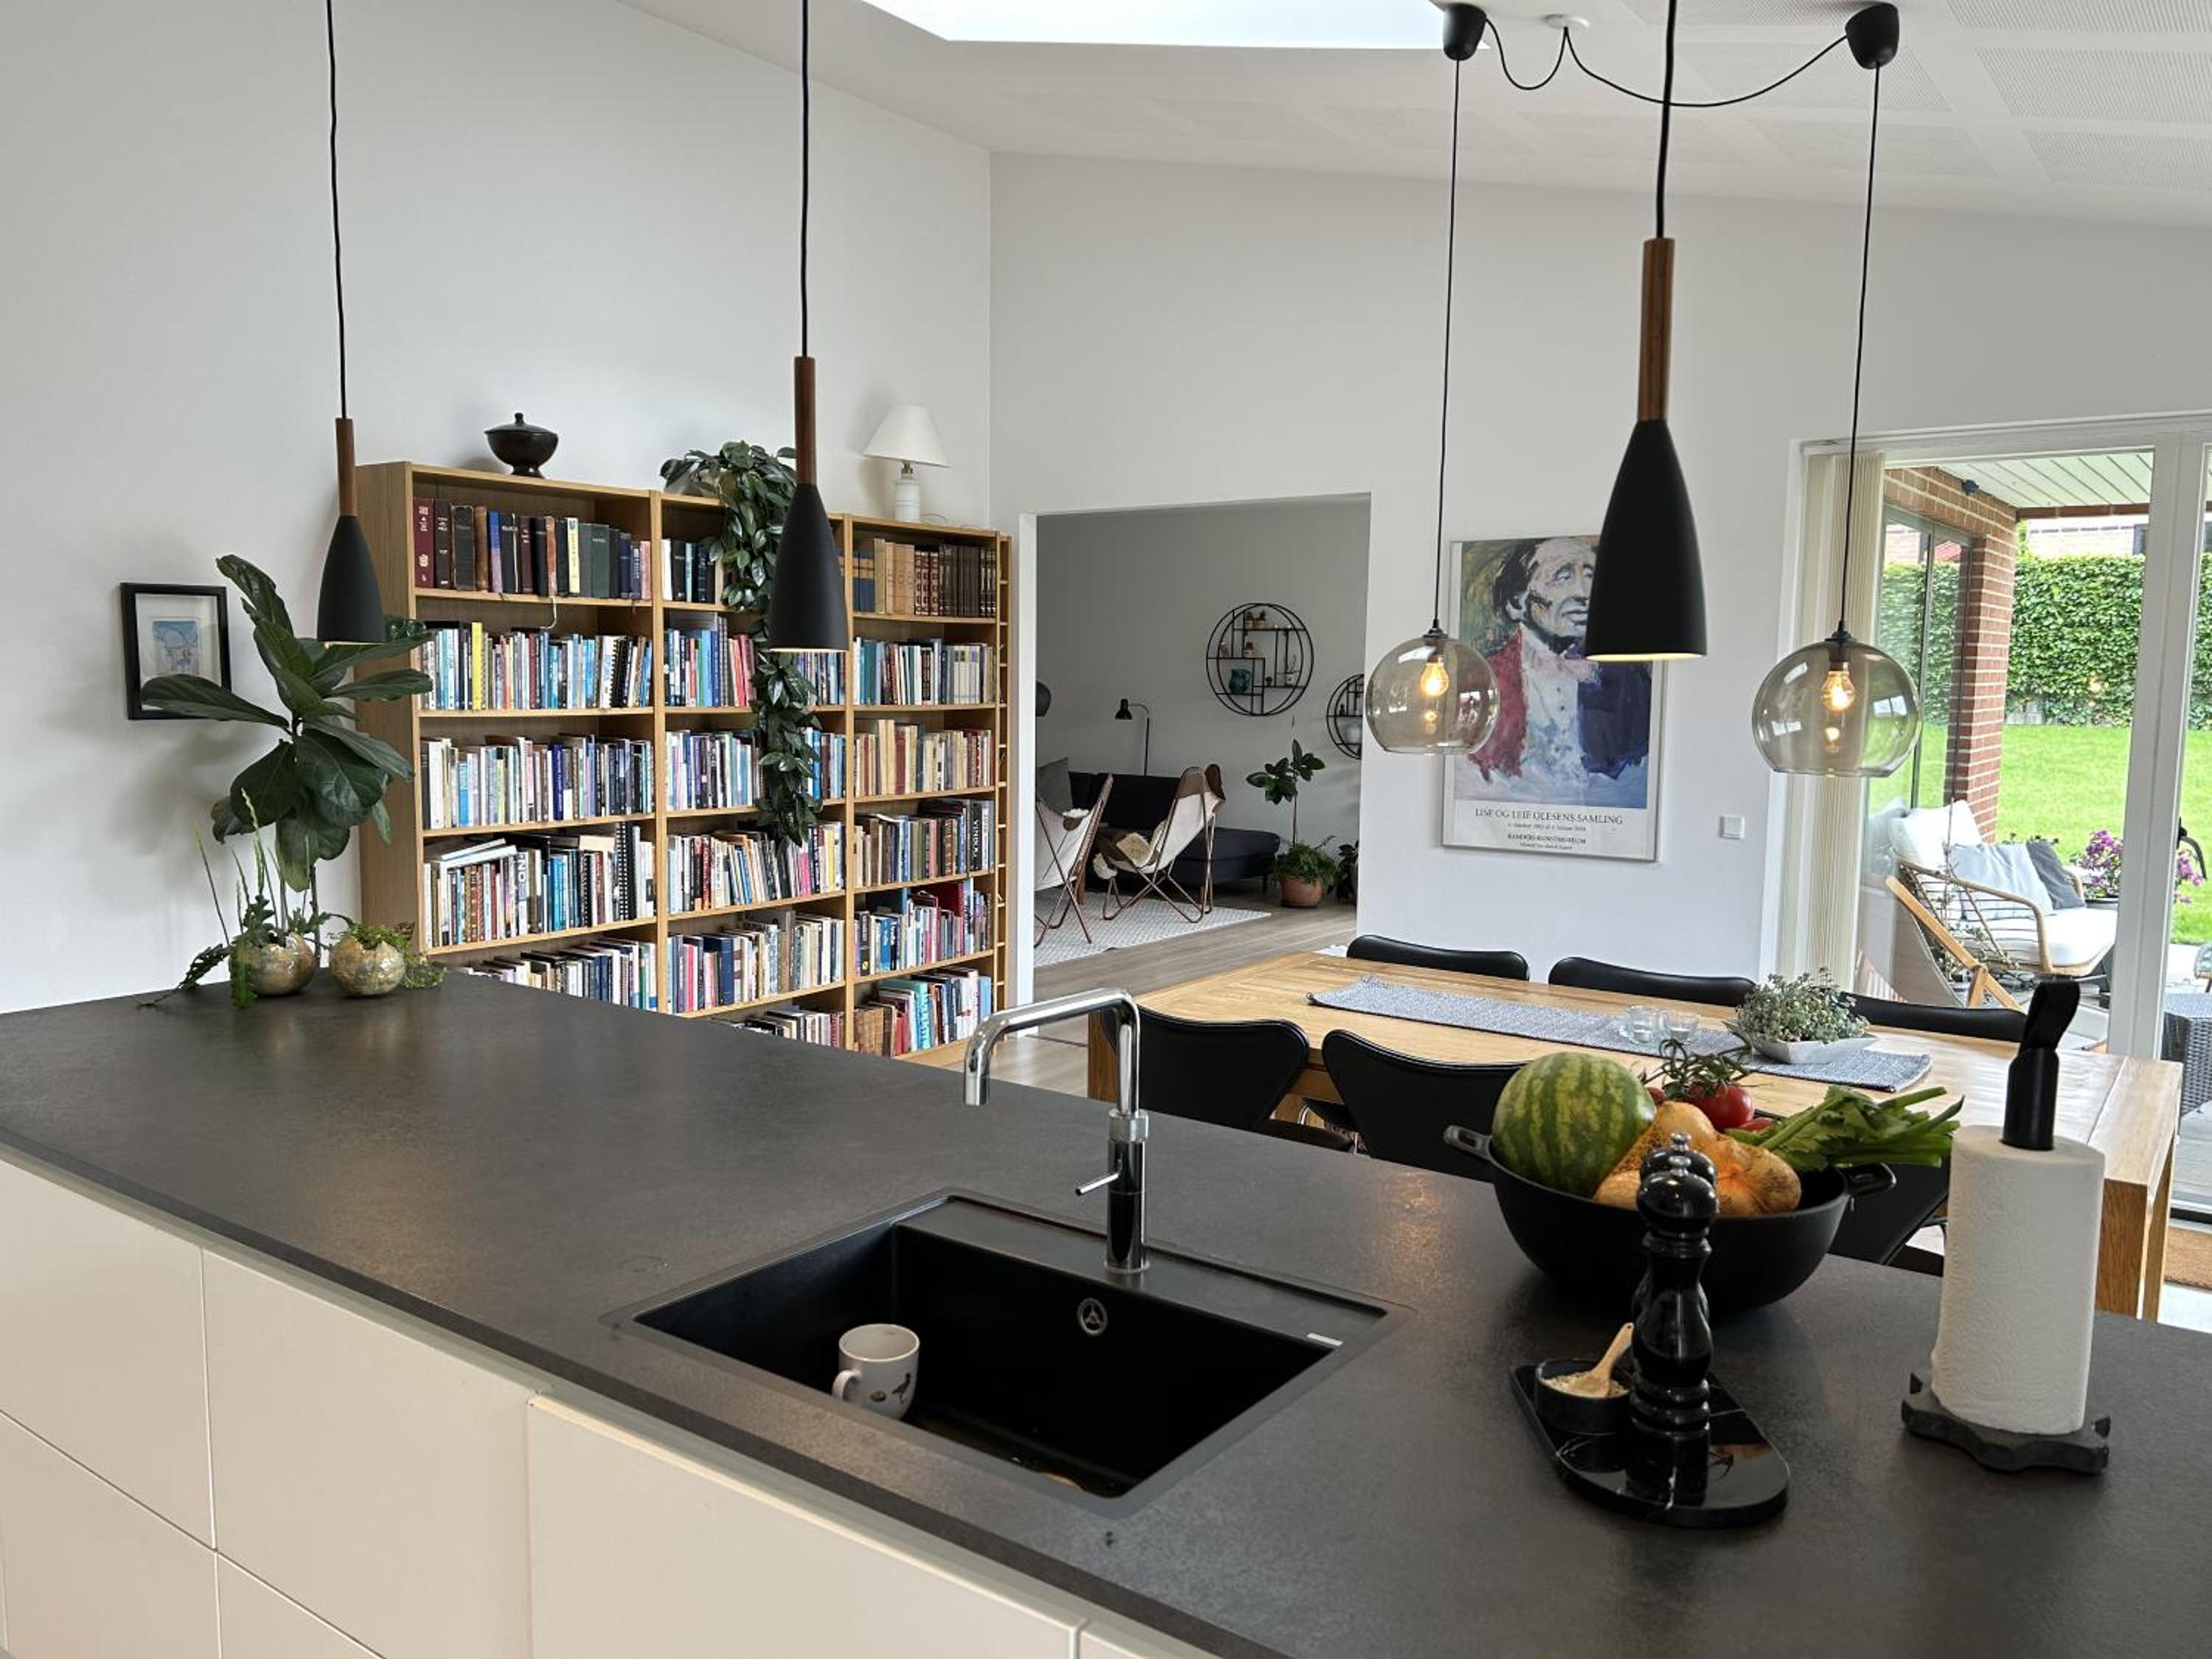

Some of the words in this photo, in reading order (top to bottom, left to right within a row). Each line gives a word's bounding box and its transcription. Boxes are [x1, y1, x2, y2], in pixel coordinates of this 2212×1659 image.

[1475, 808, 1494, 818] LISE
[1495, 809, 1510, 818] OG
[1512, 810, 1531, 819] LEIF
[1533, 811, 1576, 822] OLESENS
[1577, 813, 1623, 824] SAMLING
